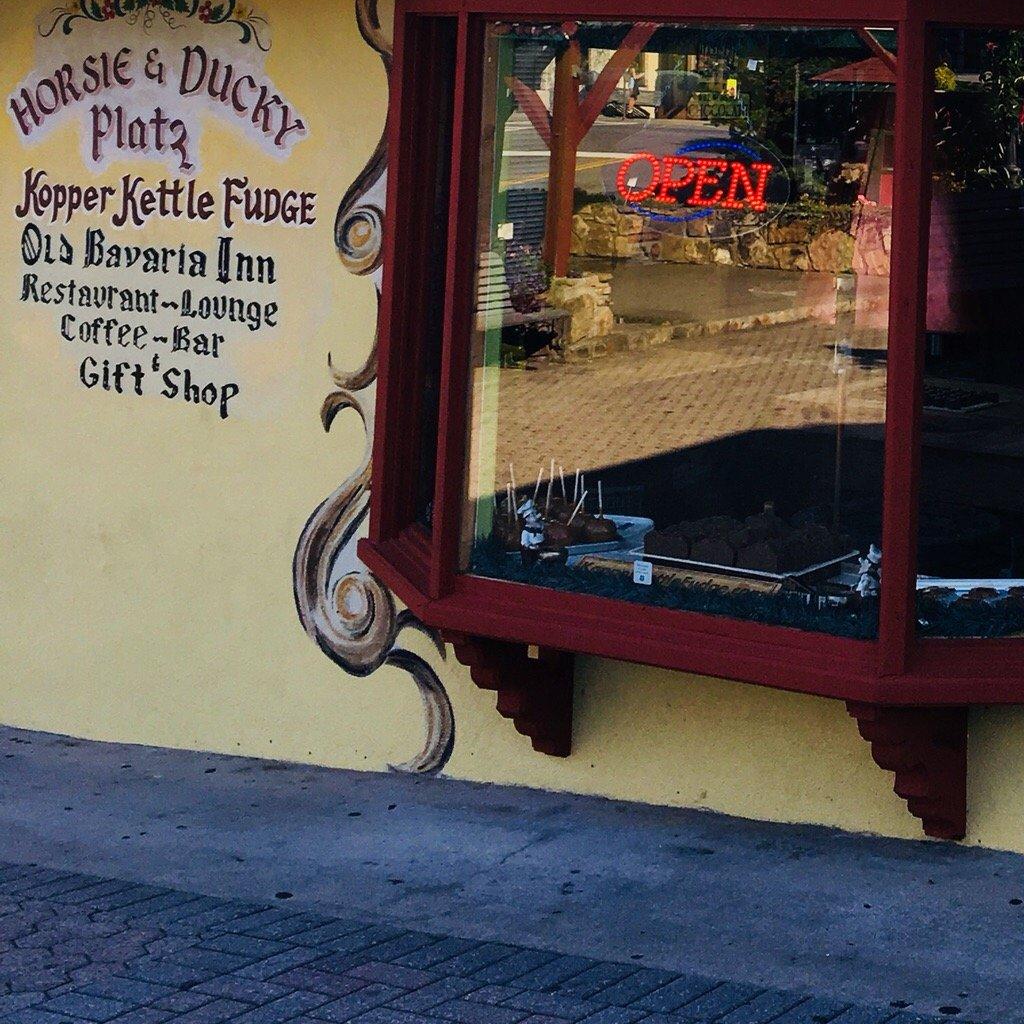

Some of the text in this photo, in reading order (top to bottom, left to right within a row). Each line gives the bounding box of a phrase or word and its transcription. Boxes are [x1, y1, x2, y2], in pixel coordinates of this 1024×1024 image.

[10, 45, 306, 147] HORSIE & DUCKY
[15, 168, 317, 228] Kopper Kettle FUDGE
[614, 152, 774, 212] OPEN
[21, 222, 277, 284] Old Bavaria Inn
[80, 356, 146, 396] Gift
[160, 367, 240, 419] Shop
